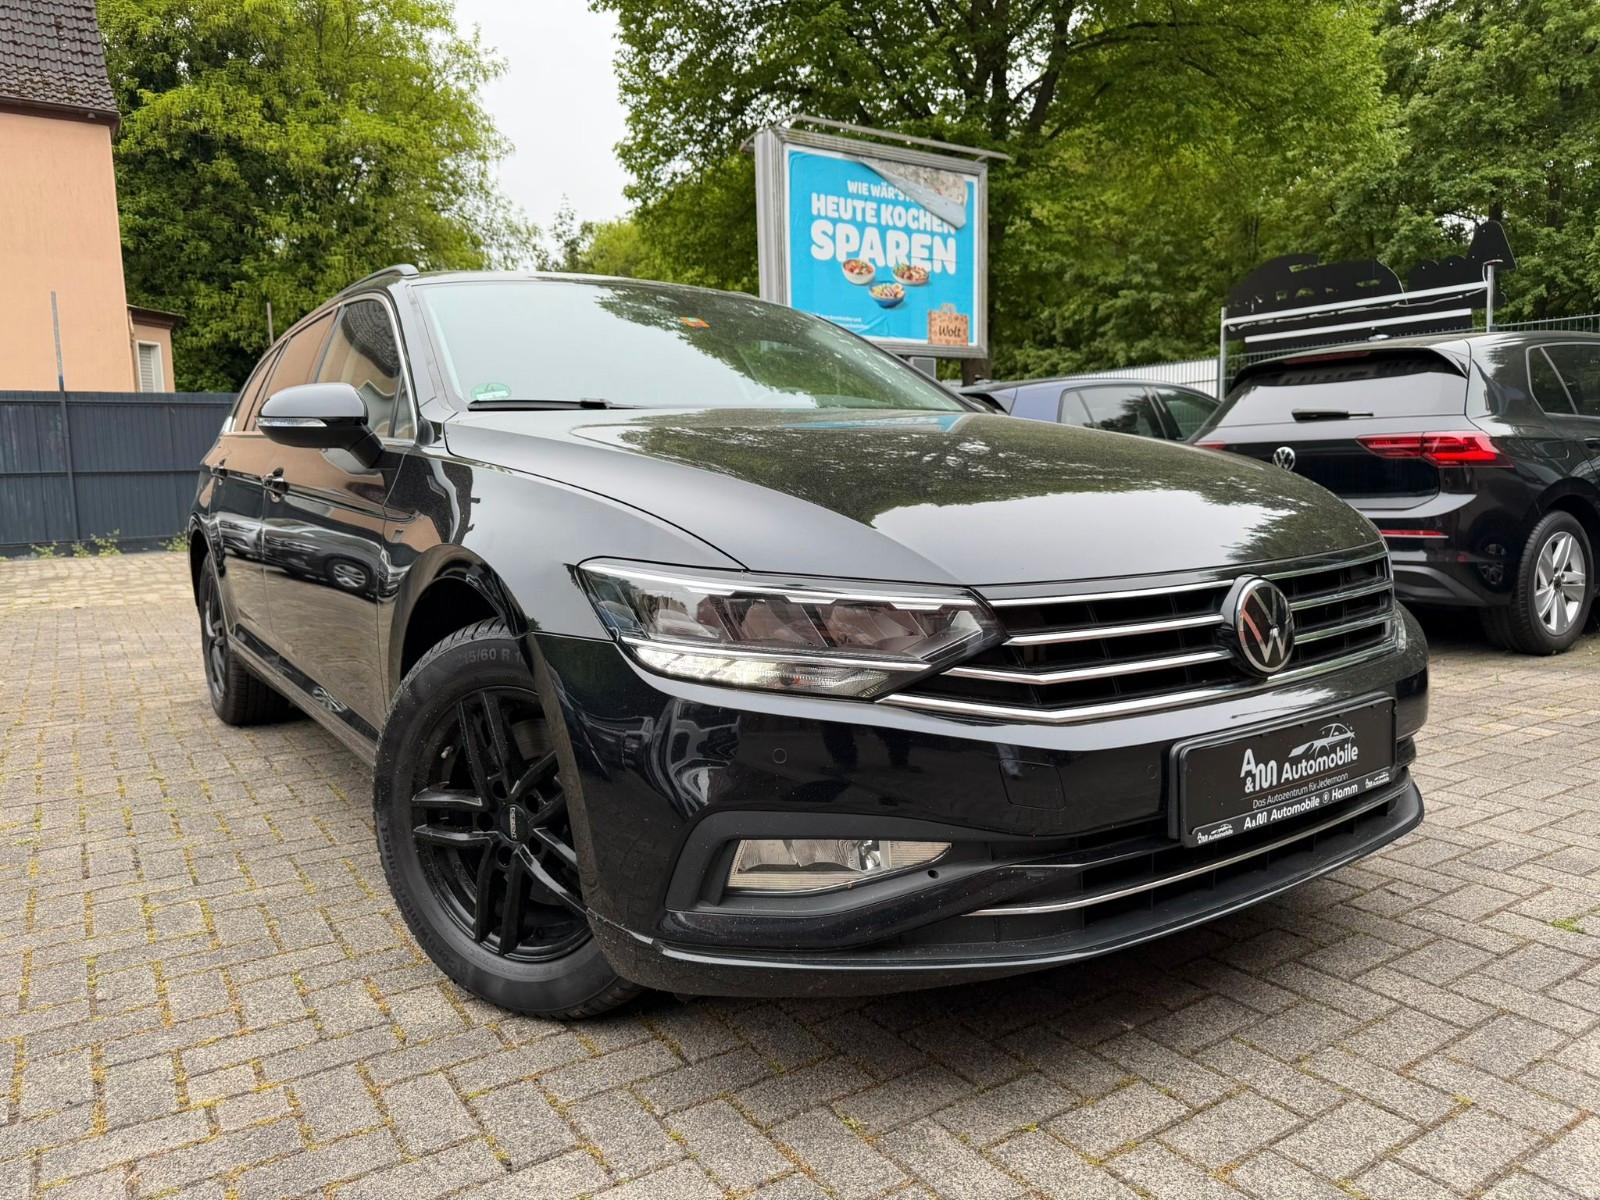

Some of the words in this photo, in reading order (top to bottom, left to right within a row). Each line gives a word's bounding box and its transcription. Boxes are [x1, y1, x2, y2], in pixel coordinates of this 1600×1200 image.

[847, 180, 869, 196] WIE
[811, 192, 878, 224] HEUTE
[811, 220, 957, 274] SPAREN
[938, 324, 962, 338] Wolt
[501, 648, 511, 662] R
[1281, 743, 1359, 783] Automobile
[1252, 799, 1266, 809] Das
[1267, 786, 1308, 804] Autozentrum
[1317, 772, 1349, 790] Jedermann
[1270, 795, 1320, 822] Automobile
[1332, 783, 1358, 801] Hamm
